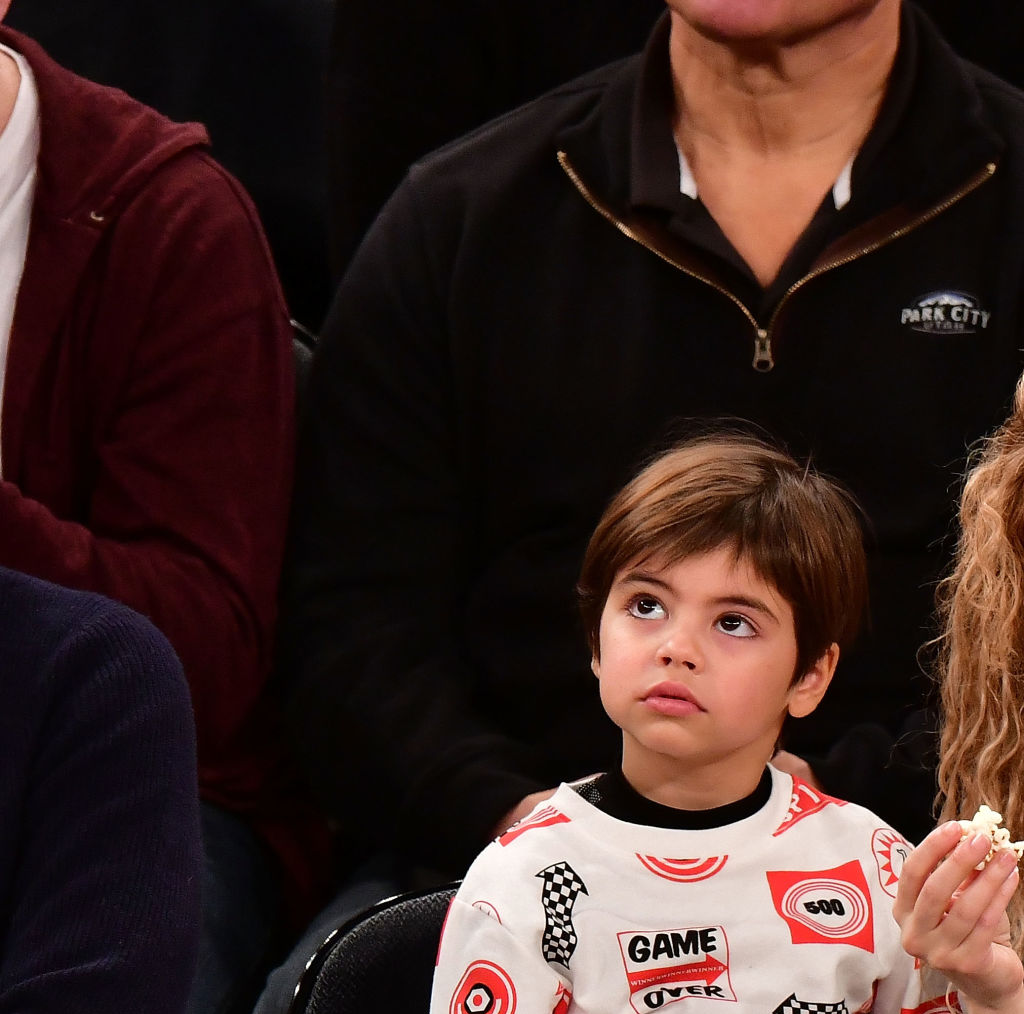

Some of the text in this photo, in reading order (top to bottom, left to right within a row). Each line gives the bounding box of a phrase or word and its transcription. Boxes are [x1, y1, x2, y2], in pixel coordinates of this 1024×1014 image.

[901, 306, 991, 329] PARK CITY
[803, 898, 846, 917] 500
[627, 927, 718, 964] GAME
[643, 985, 726, 1009] OVER
